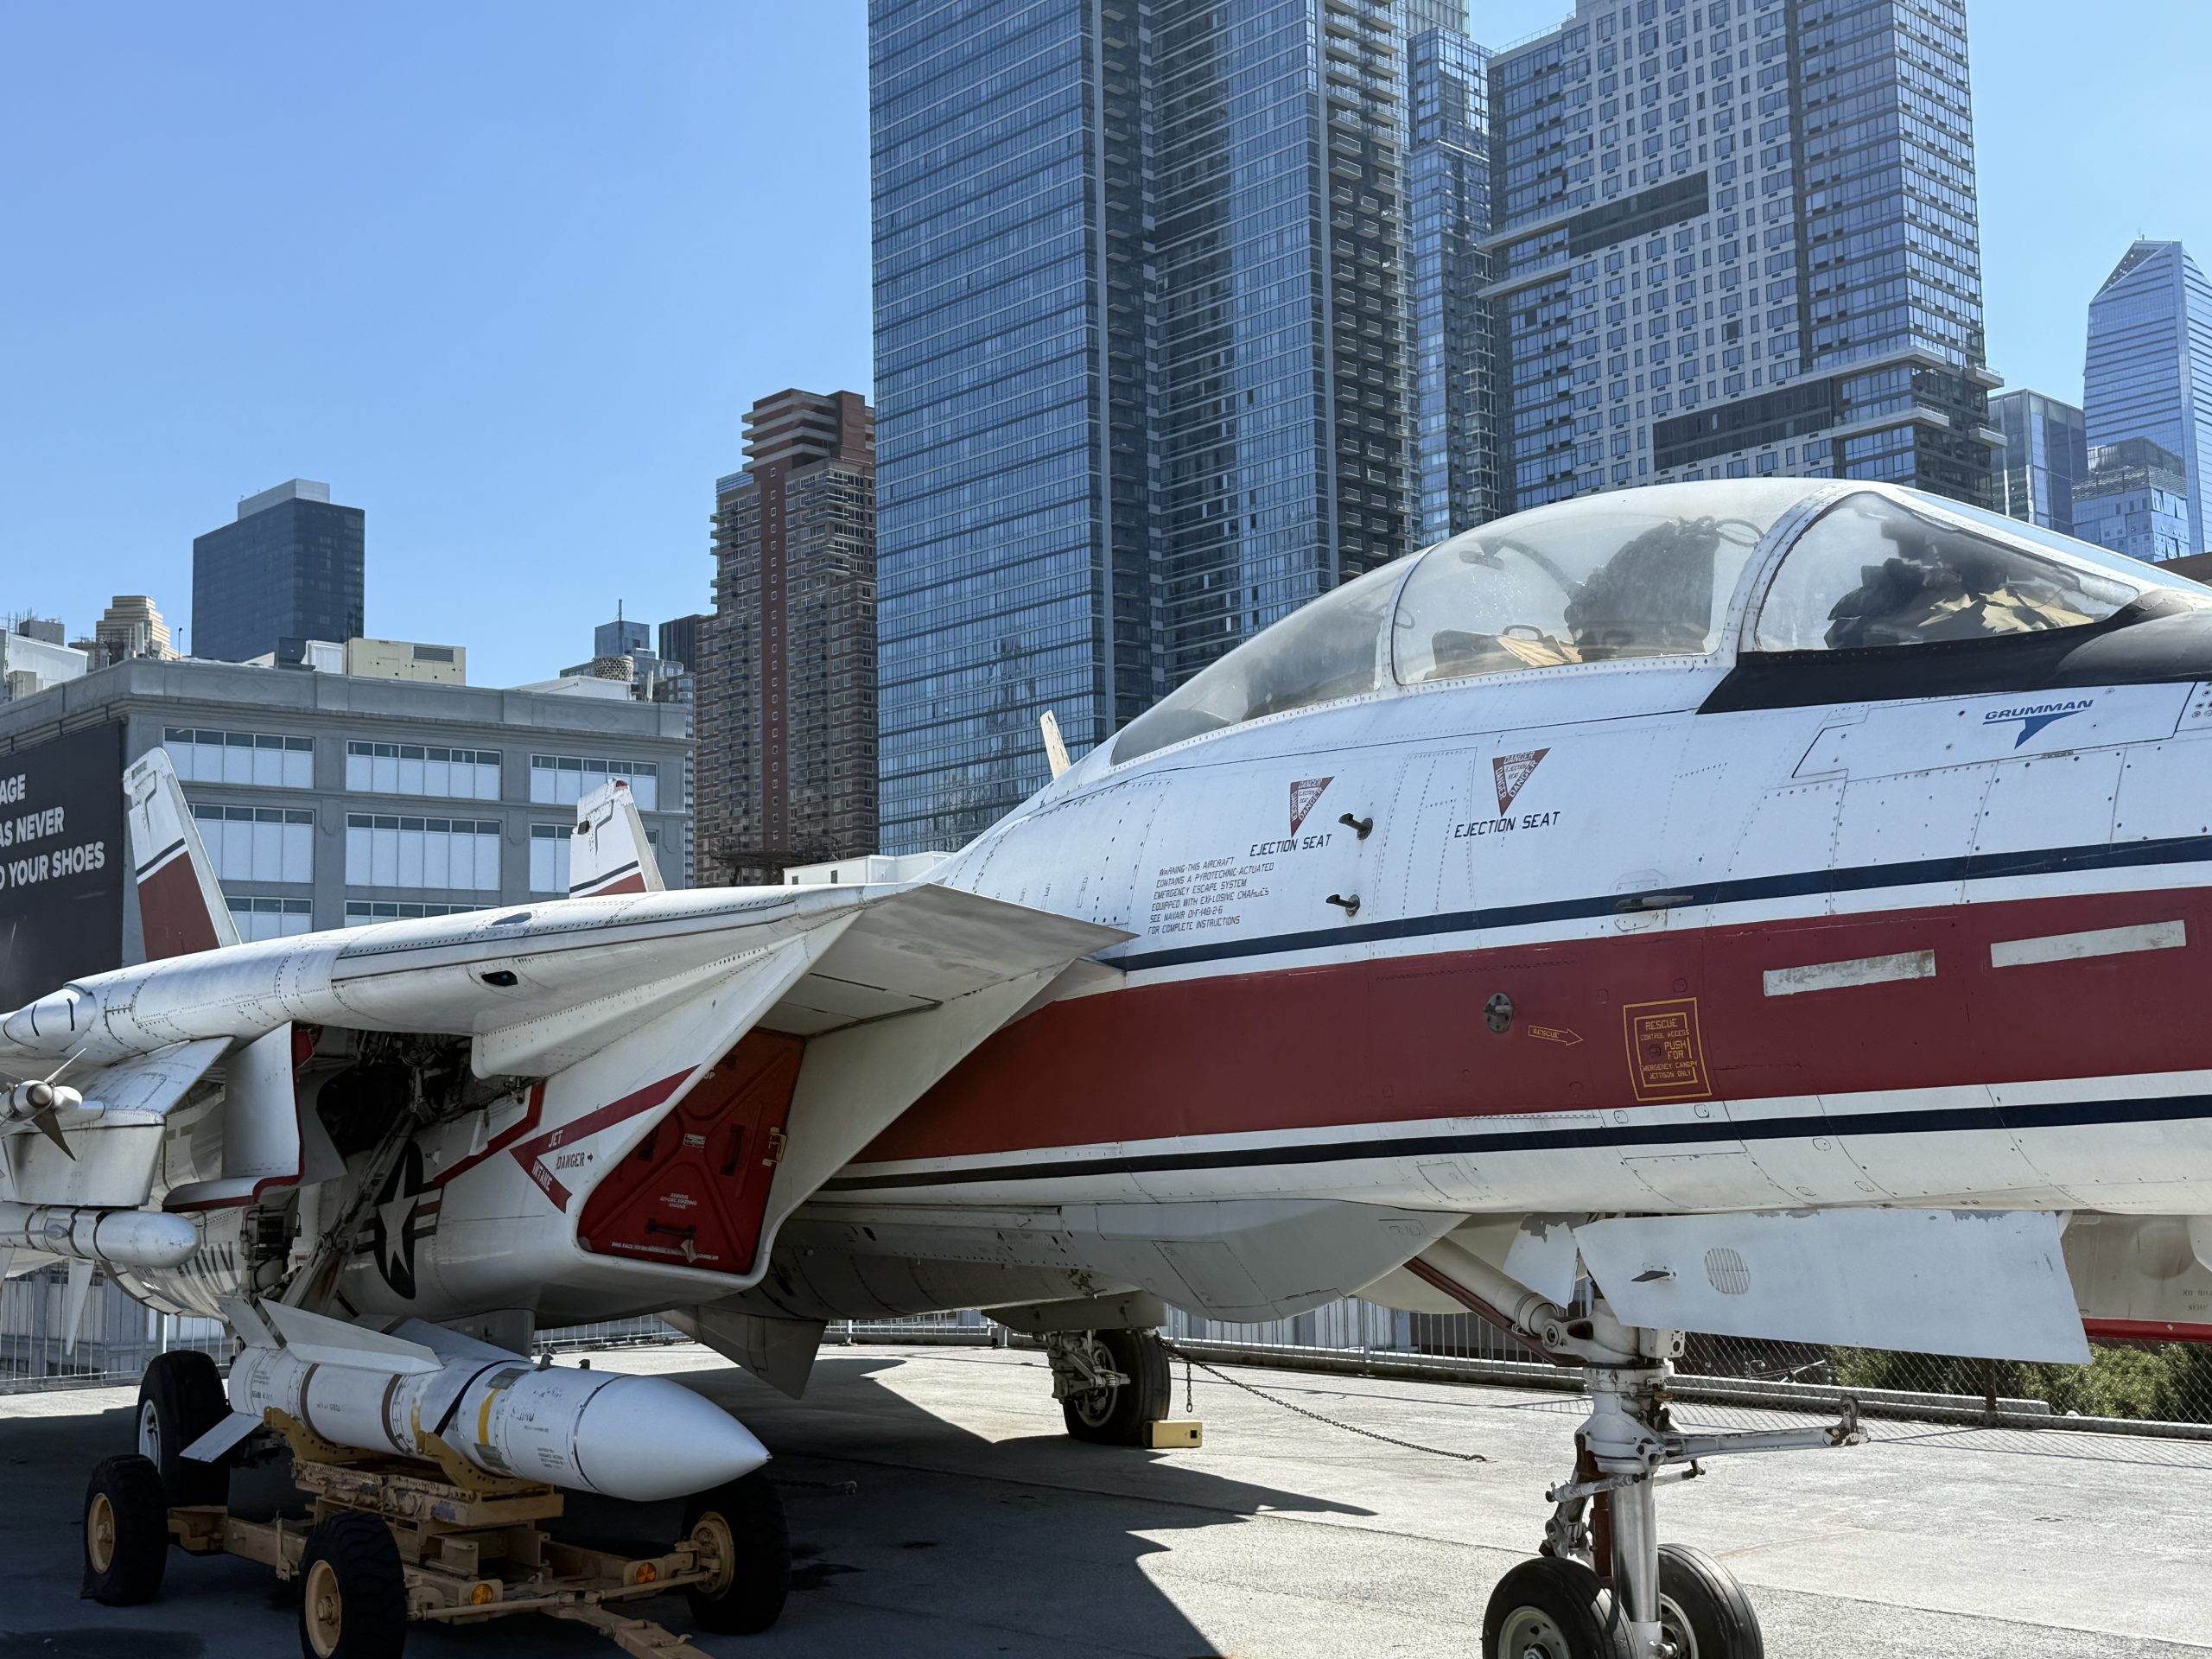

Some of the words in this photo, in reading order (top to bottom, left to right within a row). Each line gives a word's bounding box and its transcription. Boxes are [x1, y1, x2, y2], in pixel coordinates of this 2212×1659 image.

[1985, 699, 2094, 720] GRUMMAN
[1503, 751, 1535, 765] DANGER
[1298, 779, 1323, 789] DANGER
[1495, 766, 1507, 800] DANGER
[1509, 760, 1538, 798] DANGER
[0, 774, 26, 805] AGE
[1298, 786, 1323, 821] DANGER
[16, 806, 64, 843] NEVER
[1454, 817, 1516, 838] EJECTION
[1522, 810, 1560, 830] SEAT
[1249, 838, 1298, 857] EJECTION
[1302, 834, 1332, 849] SEAT
[9, 855, 49, 887] YOUR
[52, 841, 105, 878] SHOES
[1202, 856, 1235, 869] AIRCRAFT
[1154, 887, 1190, 899] EMERGENCY
[1192, 882, 1217, 893] ESCAPE
[1220, 878, 1247, 890] SYSTEM
[1156, 875, 1185, 888] CONTAINS
[1186, 874, 1192, 884] A
[1151, 899, 1180, 912] EQUIPPED
[1183, 897, 1198, 907] WITH
[1147, 925, 1160, 935] FOR
[1162, 921, 1193, 933] COMPLETE
[1196, 915, 1241, 929] INSTRUCTIONS
[1149, 913, 1161, 924] SEE
[1164, 910, 1185, 922] NAVAIR
[1645, 1018, 1678, 1030] RESCUE
[1668, 1029, 1689, 1038] ACCESS
[1664, 1039, 1687, 1050] PUSH
[1667, 1050, 1684, 1060] FOR
[1639, 1063, 1672, 1071] EMERGENCY
[1675, 1060, 1698, 1069] CANOPY
[548, 1129, 563, 1148] JET
[556, 1152, 585, 1170] DANGER
[531, 1160, 553, 1192] INTAKE
